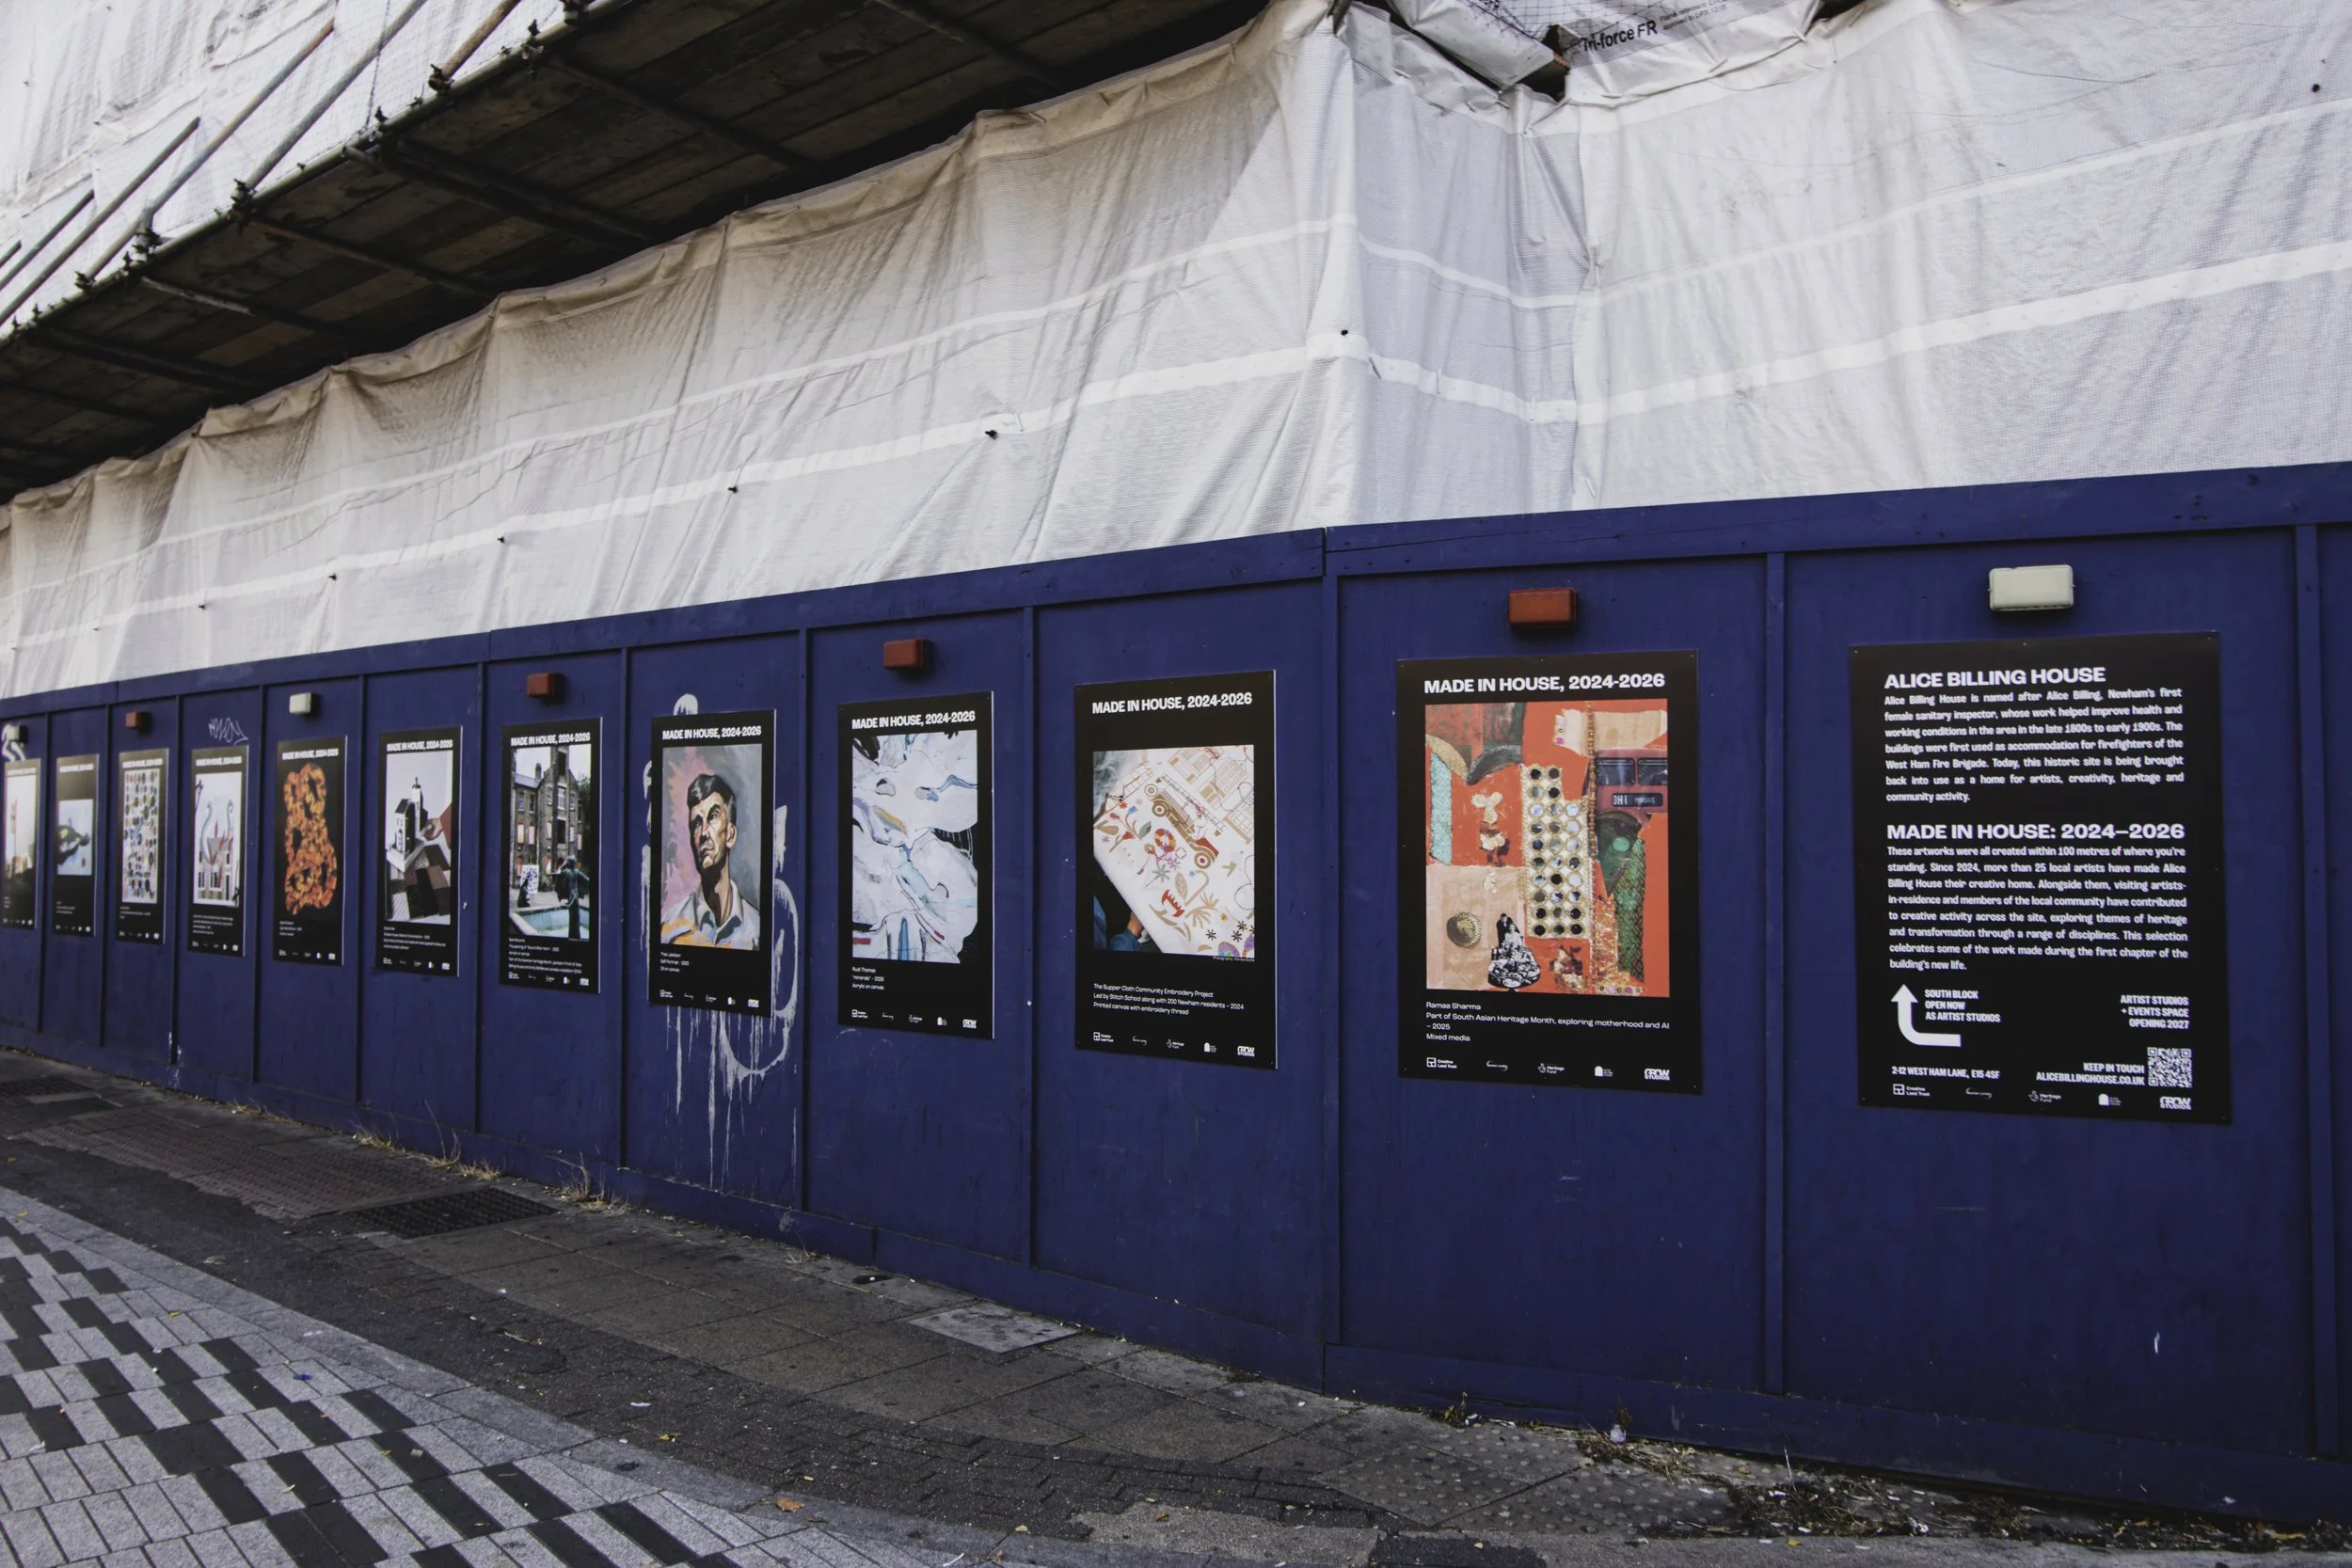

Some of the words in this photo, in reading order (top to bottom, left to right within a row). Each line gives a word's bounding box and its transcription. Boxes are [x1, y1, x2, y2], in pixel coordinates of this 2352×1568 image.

[1637, 20, 1658, 39] FR
[1424, 679, 1474, 693] MADE
[1478, 678, 1496, 692] IN
[1500, 676, 1565, 692] HOUSE,
[1568, 673, 1665, 689] 2024-2026
[1884, 673, 1944, 689] ALICE
[1947, 670, 2026, 687] BILLING
[2031, 667, 2106, 684] HOUSE
[1092, 701, 1125, 714] MADE
[1127, 700, 1139, 712] IN
[1141, 697, 1185, 711] HOUSE,
[1187, 692, 1252, 708] 2024-2026
[1884, 696, 1905, 705] Alice
[1909, 695, 1935, 706] Billing
[1939, 694, 1966, 704] House
[1971, 693, 1979, 703] is
[1983, 692, 2013, 702] named
[2018, 691, 2042, 701] after
[2046, 690, 2069, 700] Alice
[2073, 690, 2103, 702] Billing,
[2107, 689, 2155, 699] Newham's
[2159, 688, 2182, 697] first
[1884, 711, 1914, 721] female
[1915, 711, 1952, 721] sanitary
[1954, 710, 1998, 721] inspector,
[2000, 708, 2030, 718] whose
[2032, 707, 2057, 718] work
[2058, 706, 2090, 719] helped
[2091, 707, 2130, 718] improve
[2132, 705, 2162, 715] health
[2164, 705, 2183, 714] and
[852, 718, 878, 729] MADE
[879, 717, 889, 728] IN
[890, 714, 924, 727] HOUSE,
[925, 710, 976, 724] 2024-2026
[662, 729, 684, 740] MADE
[684, 729, 692, 738] IN
[693, 728, 721, 739] HOUSE,
[722, 725, 761, 737] 2024-2026
[511, 736, 529, 746] MADE
[528, 736, 535, 745] IN
[535, 735, 558, 745] HOUSE,
[1887, 824, 1947, 839] MADE
[1951, 824, 1973, 839] IN
[1978, 824, 2056, 839] HOUSE:
[1887, 847, 1913, 856] These
[1914, 847, 1955, 856] artworks
[1979, 847, 1991, 855] all
[1992, 846, 2026, 856] created
[2027, 847, 2057, 856] within
[2058, 847, 2075, 856] 100
[2076, 847, 2110, 856] metres
[2111, 846, 2122, 856] of
[2122, 846, 2153, 856] where
[2154, 847, 2185, 858] you're
[1887, 863, 1927, 874] standing.
[1930, 863, 1954, 872] Since
[1957, 863, 1980, 873] 2024,
[2010, 863, 2032, 872] than
[2035, 863, 2046, 872] 25
[2049, 863, 2071, 873] local
[2074, 863, 2106, 873] artists
[2108, 863, 2131, 873] have
[2134, 863, 2160, 873] made
[2163, 863, 2185, 873] Alice
[1135, 987, 1164, 995] Community
[1164, 989, 1194, 997] Embroidery
[1925, 990, 1952, 998] SOUTH
[1952, 990, 1979, 999] BLOCK
[1141, 996, 1155, 1005] along
[1925, 1000, 1947, 1009] OPEN
[1947, 1001, 1965, 1010] NOW
[2121, 994, 2152, 1005] ARTIST
[2151, 995, 2189, 1006] STUDIOS
[1141, 1006, 1170, 1015] embroidery
[1925, 1011, 1937, 1021] AS
[1937, 1012, 1965, 1022] ARTIST
[1965, 1013, 2001, 1022] STUDIOS
[2128, 1006, 2161, 1017] EVENTS
[2161, 1007, 2189, 1018] SPACE
[1497, 1016, 1529, 1024] Heritage
[1558, 1019, 1594, 1027] exploring
[1595, 1020, 1644, 1028] motherhood
[2129, 1018, 2167, 1028] OPENING
[2167, 1020, 2189, 1029] 2027
[1892, 1066, 1907, 1075] 2-12
[1907, 1067, 1929, 1075] WEST
[1929, 1068, 1947, 1076] HAM
[1947, 1069, 1969, 1079] LANE,
[1971, 1069, 1984, 1078] E15
[1985, 1070, 2000, 1079] 4SF
[2083, 1062, 2105, 1072] KEEP
[2106, 1063, 2115, 1072] IN
[2115, 1064, 2145, 1074] TOUCH
[2036, 1071, 2145, 1085] ALICEBILLINGHOUSE.CO.UK
[2159, 1096, 2191, 1105] GROW
